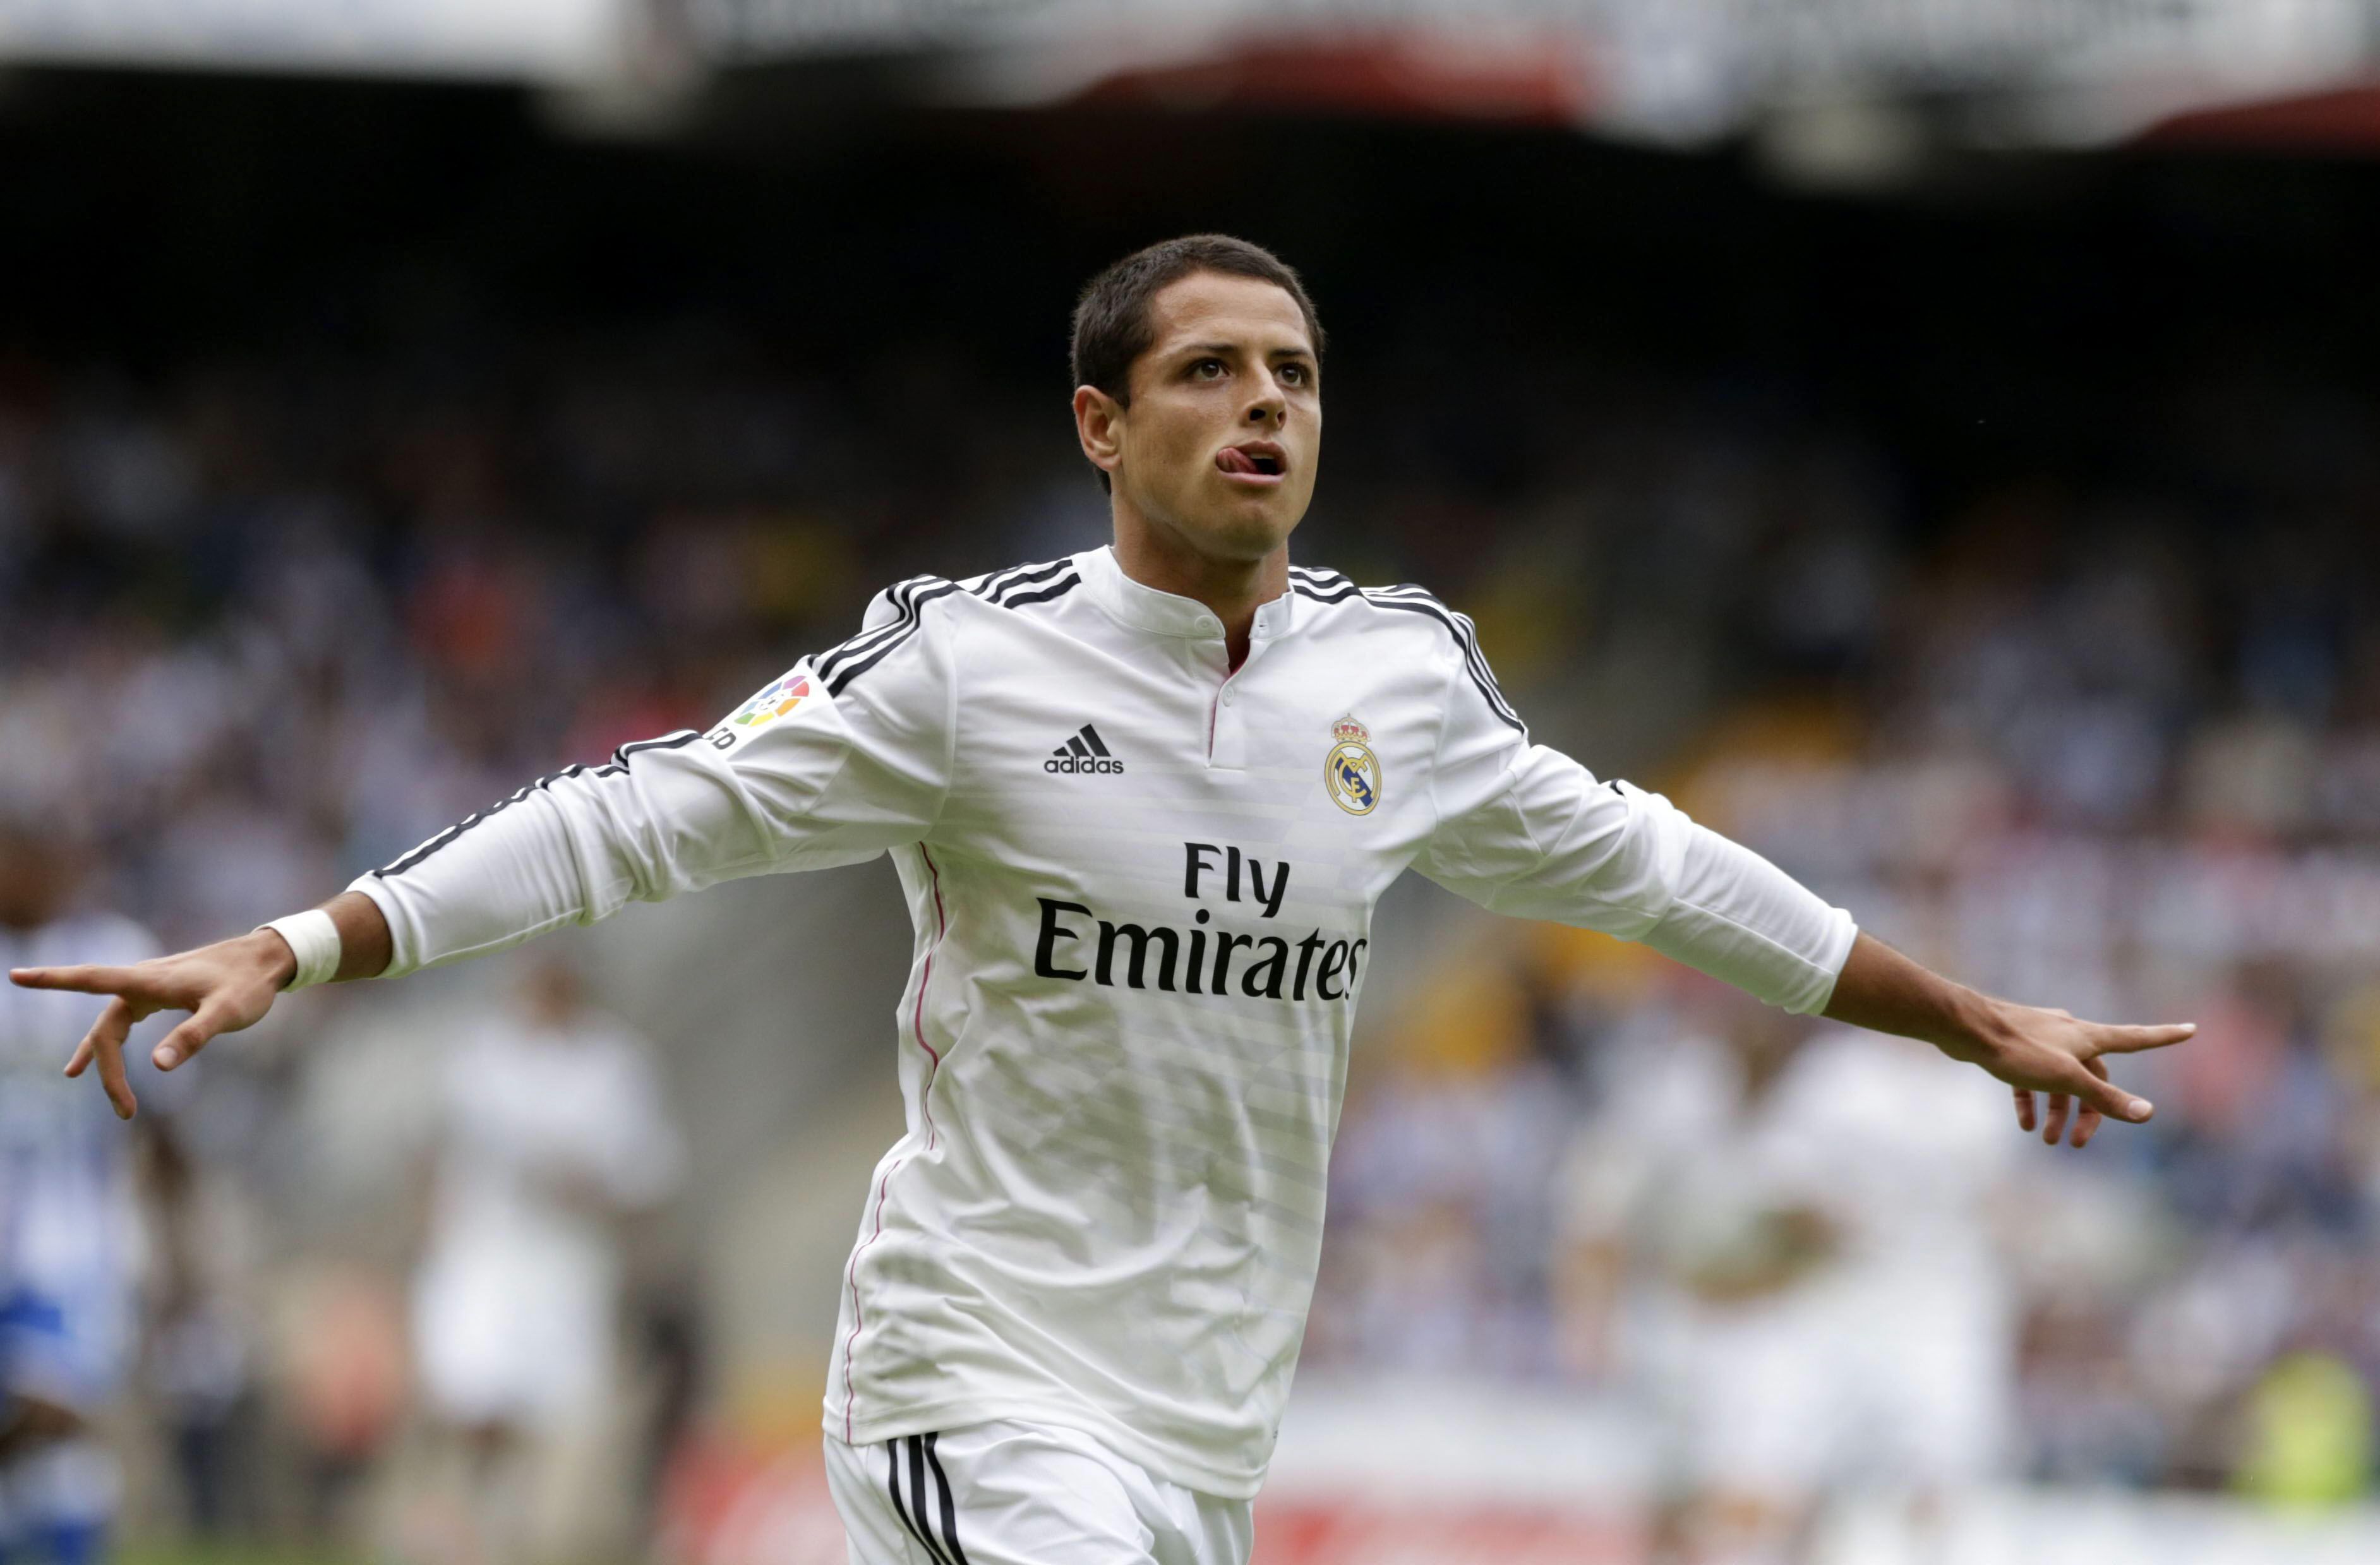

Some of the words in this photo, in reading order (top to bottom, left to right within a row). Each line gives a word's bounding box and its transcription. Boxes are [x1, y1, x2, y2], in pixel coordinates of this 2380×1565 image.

[1043, 756, 1124, 774] adidas
[1184, 842, 1290, 919] Fly
[1034, 897, 1368, 1002] Emirates
